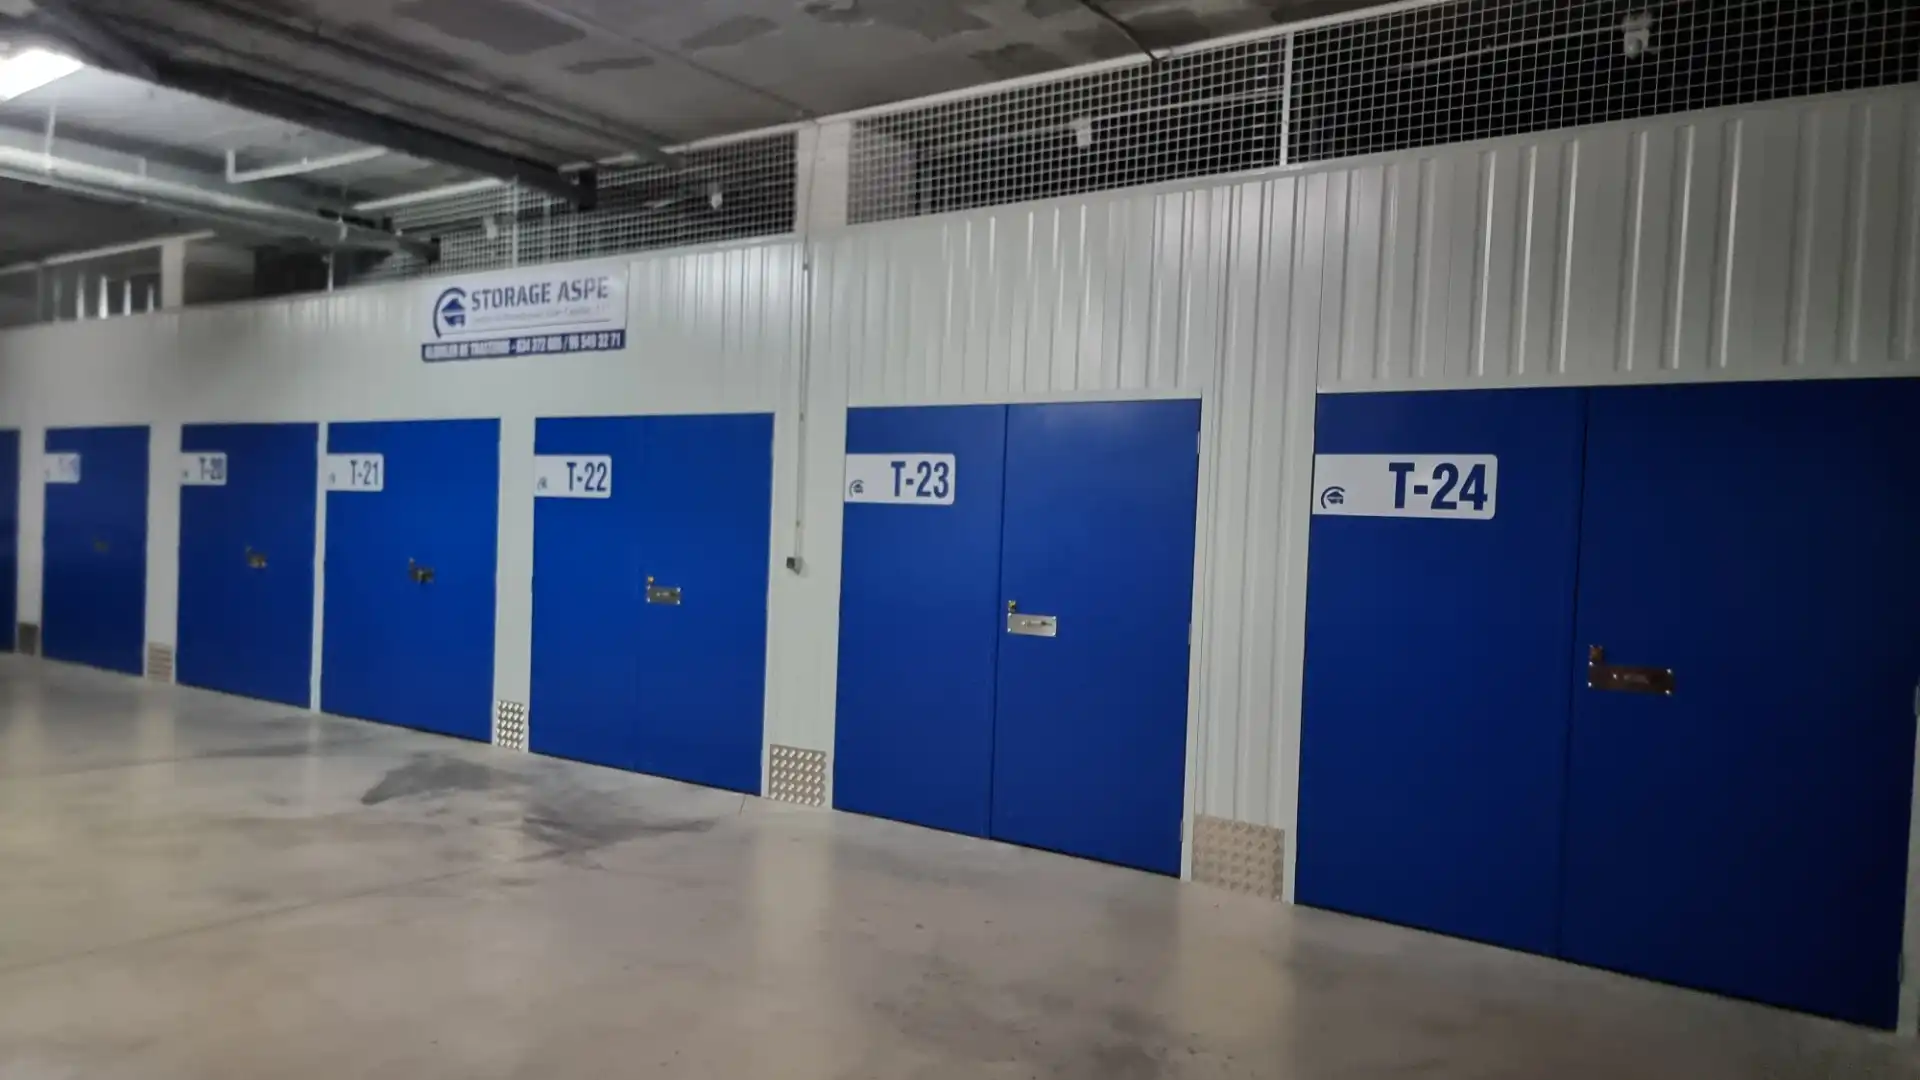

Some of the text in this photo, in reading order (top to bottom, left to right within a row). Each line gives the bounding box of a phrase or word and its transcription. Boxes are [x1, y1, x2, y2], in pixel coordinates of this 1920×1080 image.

[471, 276, 610, 312] STORAGE ASPE
[350, 460, 379, 486] T-21
[567, 462, 607, 492] T-22
[890, 460, 950, 499] T-23
[1388, 462, 1488, 511] T-24
